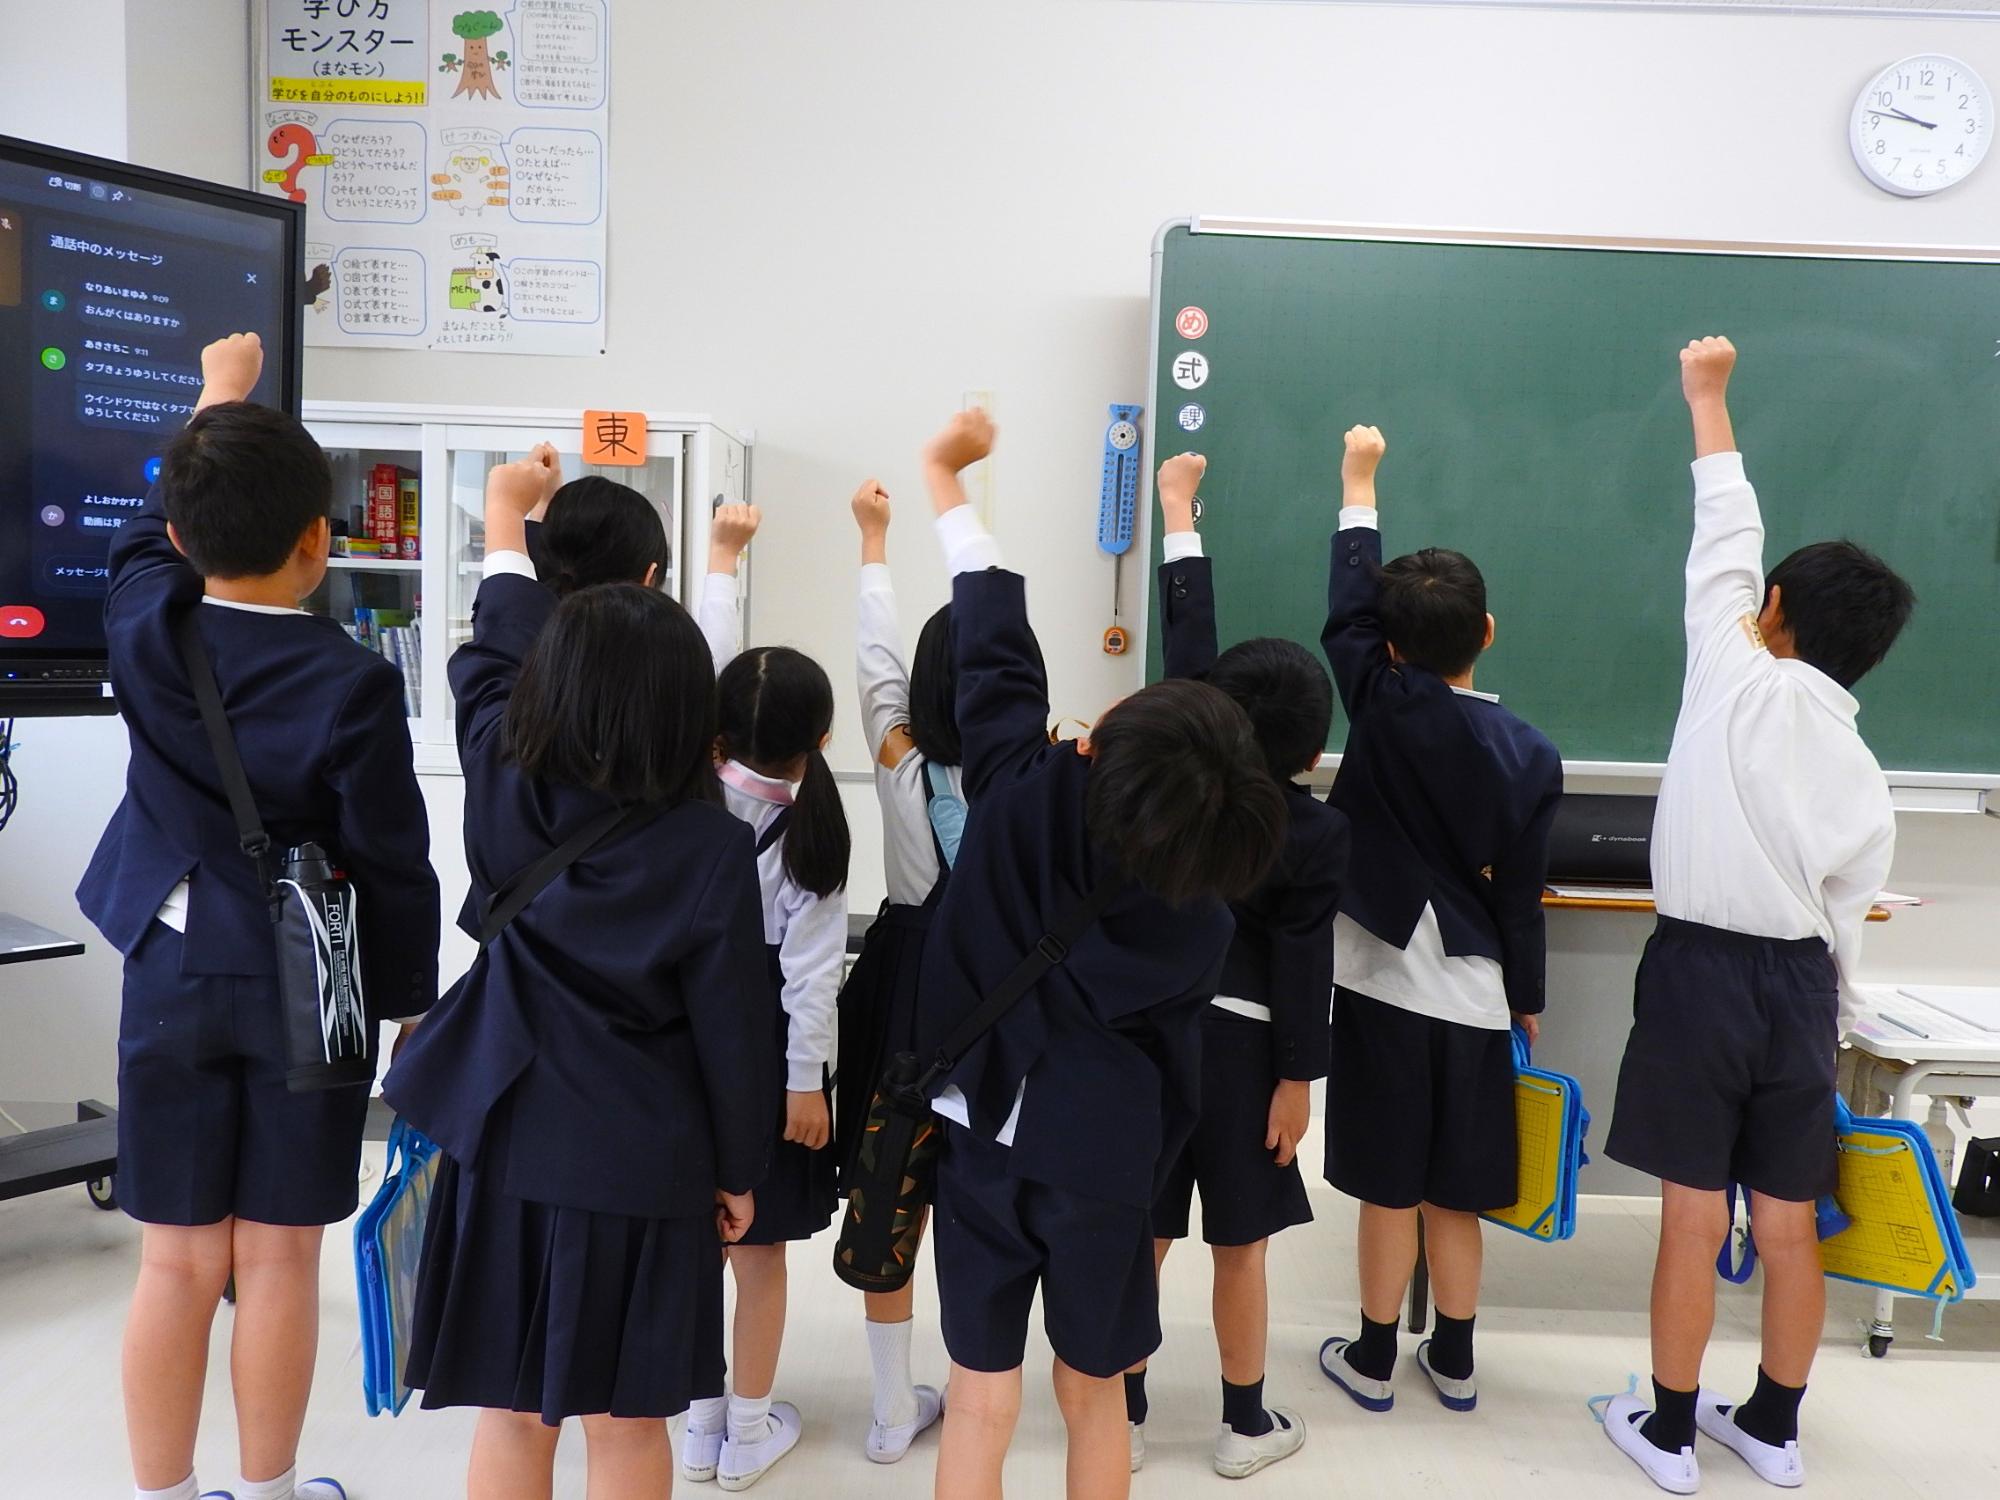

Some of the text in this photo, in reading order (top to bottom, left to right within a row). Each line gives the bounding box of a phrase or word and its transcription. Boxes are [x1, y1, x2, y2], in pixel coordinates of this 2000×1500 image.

[281, 28, 414, 55] モンスター
[313, 60, 385, 78] (まなモン)
[1897, 75, 1910, 90] 11
[1920, 70, 1935, 86] 12
[1877, 91, 1893, 107] 10
[1958, 94, 1969, 110] 2
[1870, 115, 1881, 130] 9
[1965, 118, 1976, 134] 3
[1875, 139, 1886, 155] 8
[1954, 143, 1964, 157] 4
[1887, 157, 1902, 177] 7
[1913, 164, 1923, 178] 6
[1936, 159, 1946, 174] 5
[50, 234, 164, 267] 通話中のメッセージ
[85, 281, 148, 301] なりあいまゆみ
[451, 285, 480, 295] MEMO
[85, 304, 181, 329] おんがくはありますか
[1182, 312, 1203, 332] め
[85, 339, 131, 355] あきさちこ
[85, 361, 206, 387] タブきょうゆうしてください
[1177, 357, 1203, 384] 式
[84, 407, 161, 424] ゆうしてください
[1181, 407, 1203, 429] 課
[593, 412, 638, 457] 東
[83, 515, 128, 529] 動画は見
[327, 903, 344, 944] FORTI
